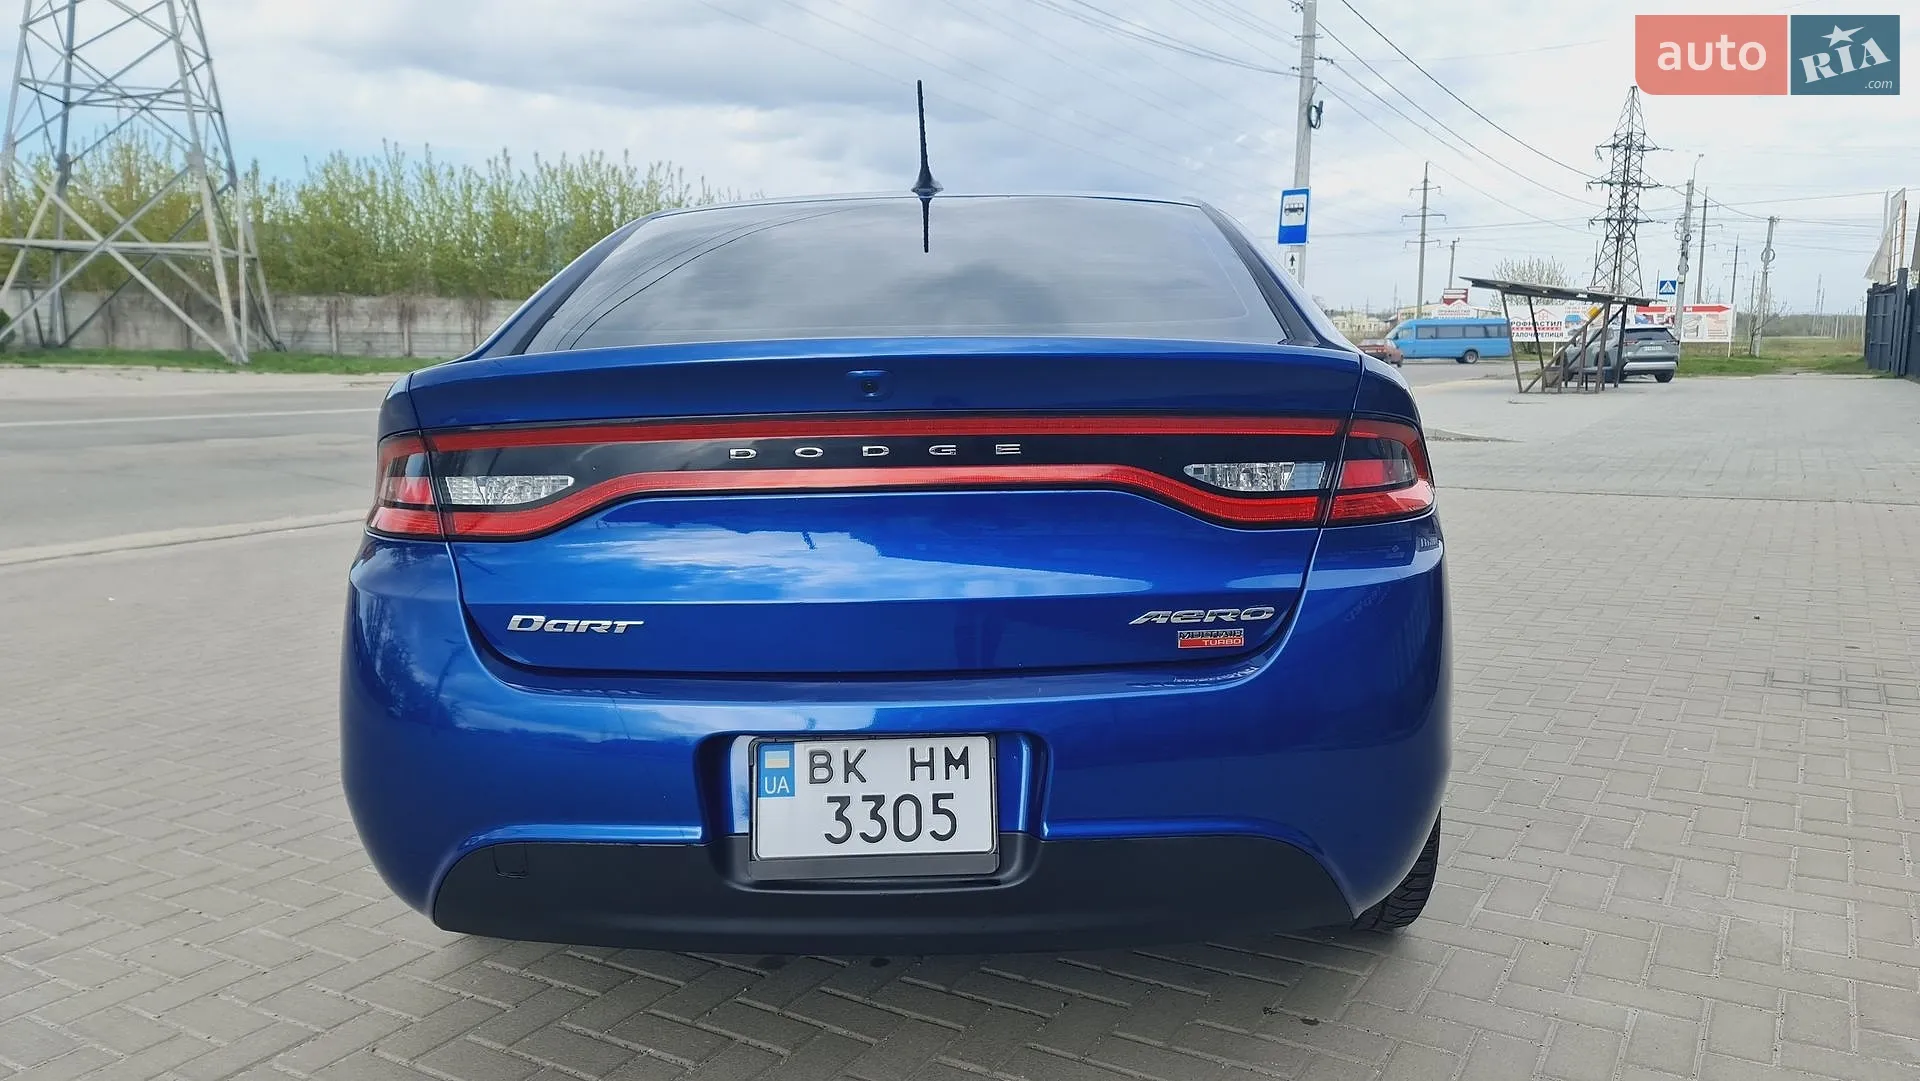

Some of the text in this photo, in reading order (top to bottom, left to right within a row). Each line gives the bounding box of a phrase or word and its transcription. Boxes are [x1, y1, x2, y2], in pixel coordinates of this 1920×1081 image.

[729, 443, 1022, 460] DODGE
[1202, 639, 1242, 647] TURBO
[764, 776, 790, 794] UA
[824, 792, 958, 845] 3305
